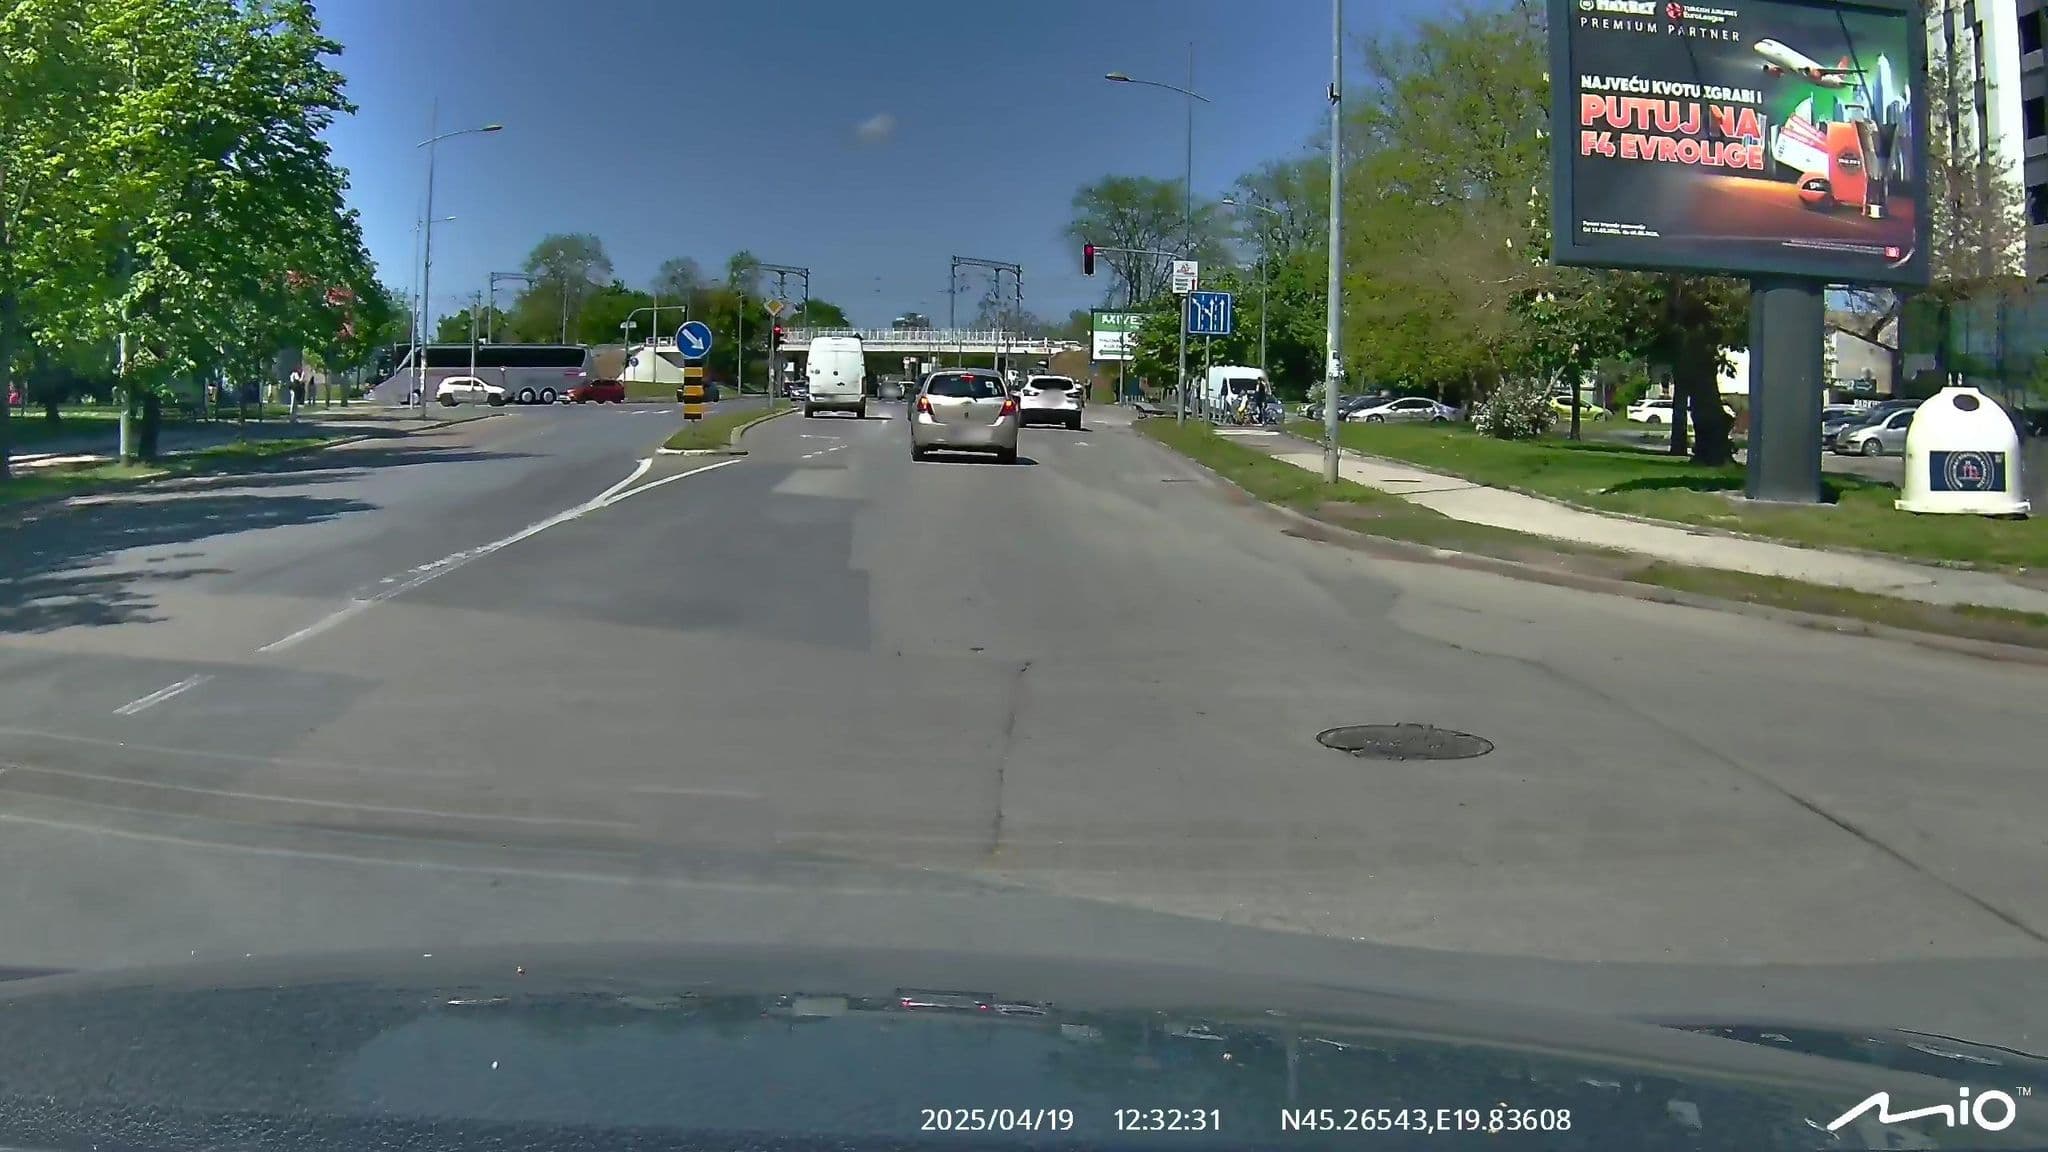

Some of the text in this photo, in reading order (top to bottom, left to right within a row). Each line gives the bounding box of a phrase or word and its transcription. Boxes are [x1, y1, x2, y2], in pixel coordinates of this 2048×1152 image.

[1580, 16, 1740, 42] PREMIUM PARTNER
[1581, 75, 1650, 94] NAJVEĆU
[1652, 80, 1701, 98] KVOTU
[1581, 93, 1763, 139] PUTUJ NA
[1581, 130, 1764, 170] F4 EVROLIGE
